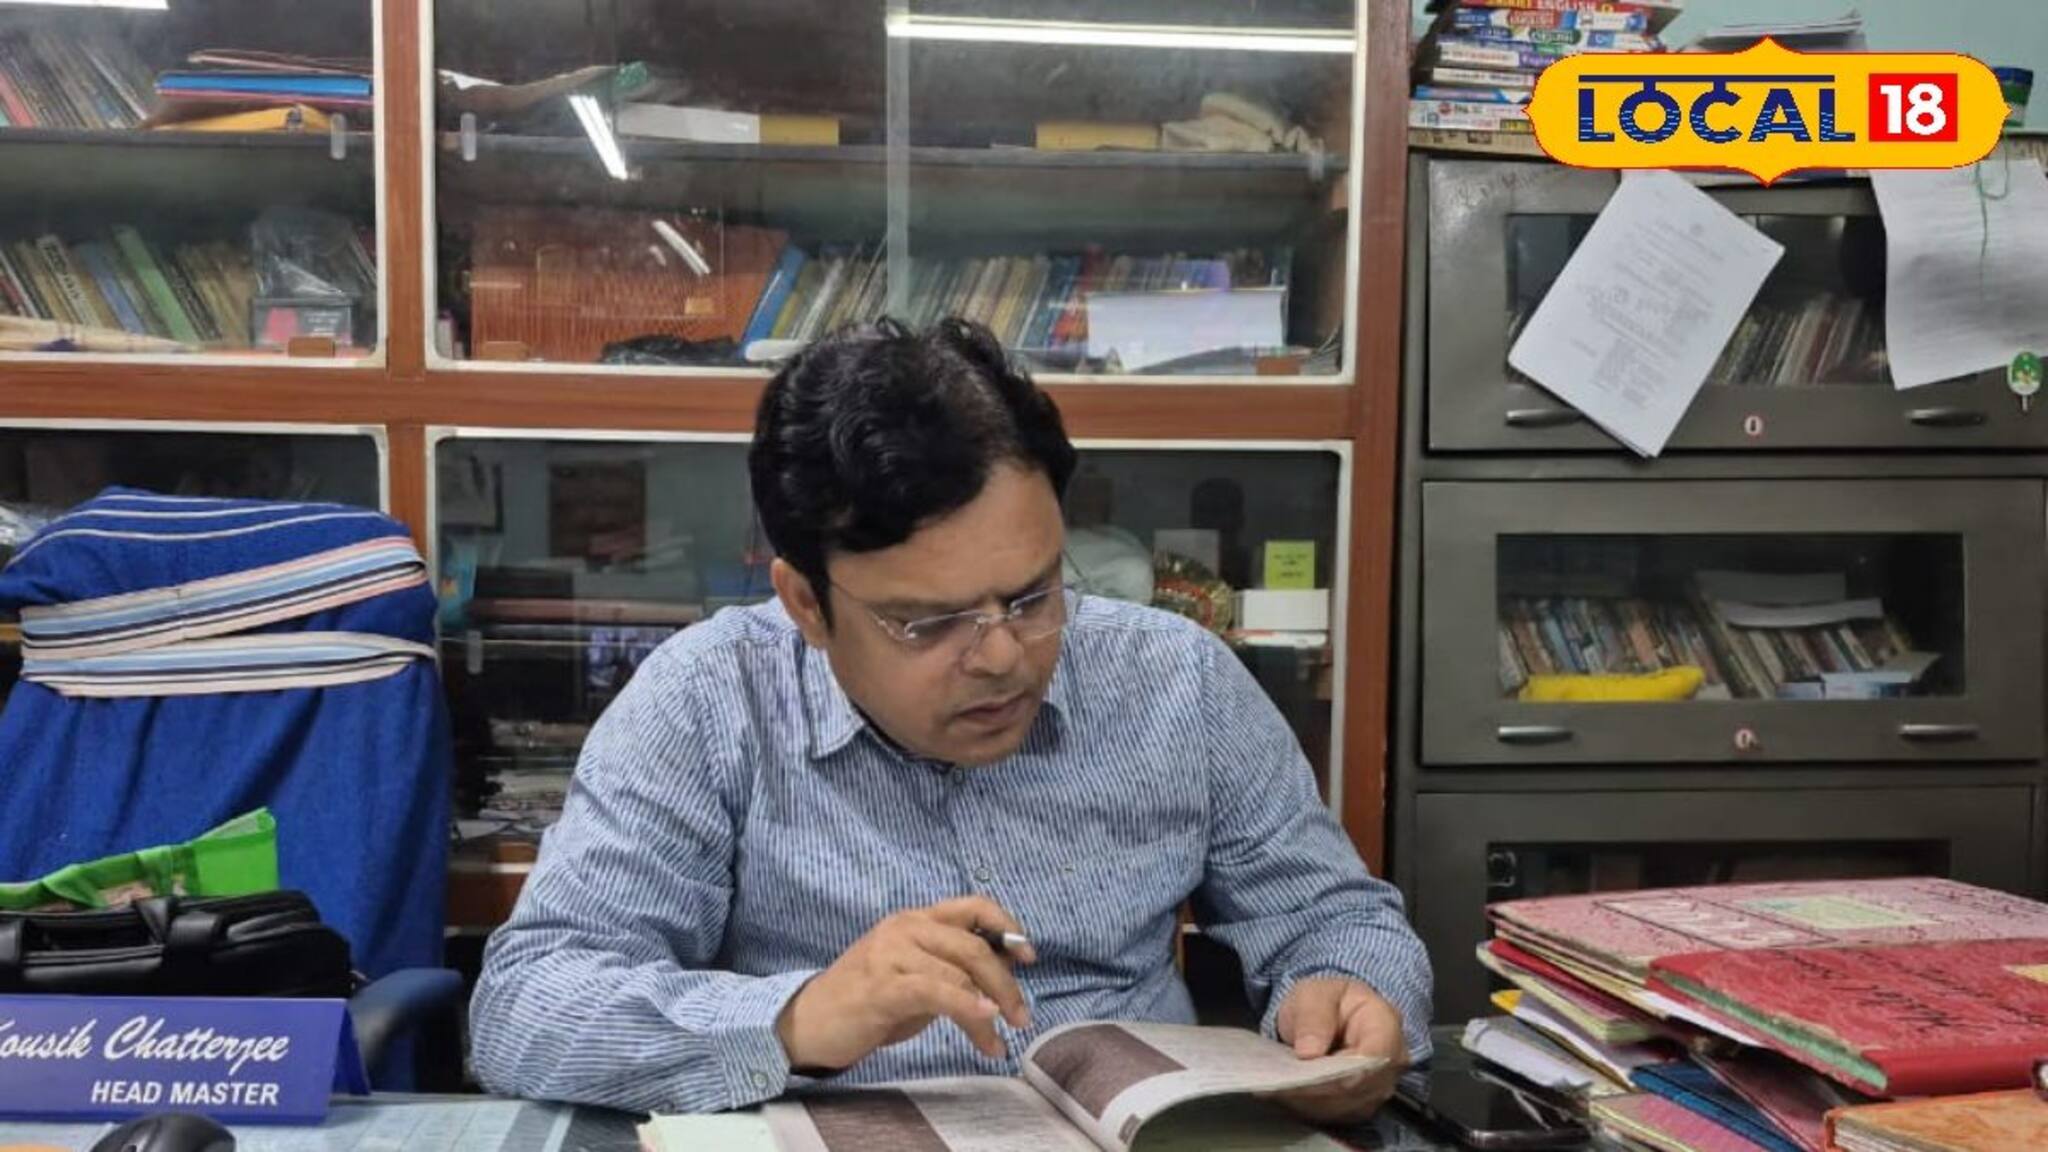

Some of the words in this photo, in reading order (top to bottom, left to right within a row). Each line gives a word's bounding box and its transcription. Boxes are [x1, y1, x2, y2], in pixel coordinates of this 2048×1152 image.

[0, 1019, 97, 1060] ousik
[104, 1015, 290, 1076] Chatterjee
[91, 1080, 163, 1104] HEAD
[169, 1081, 280, 1106] MASTER
